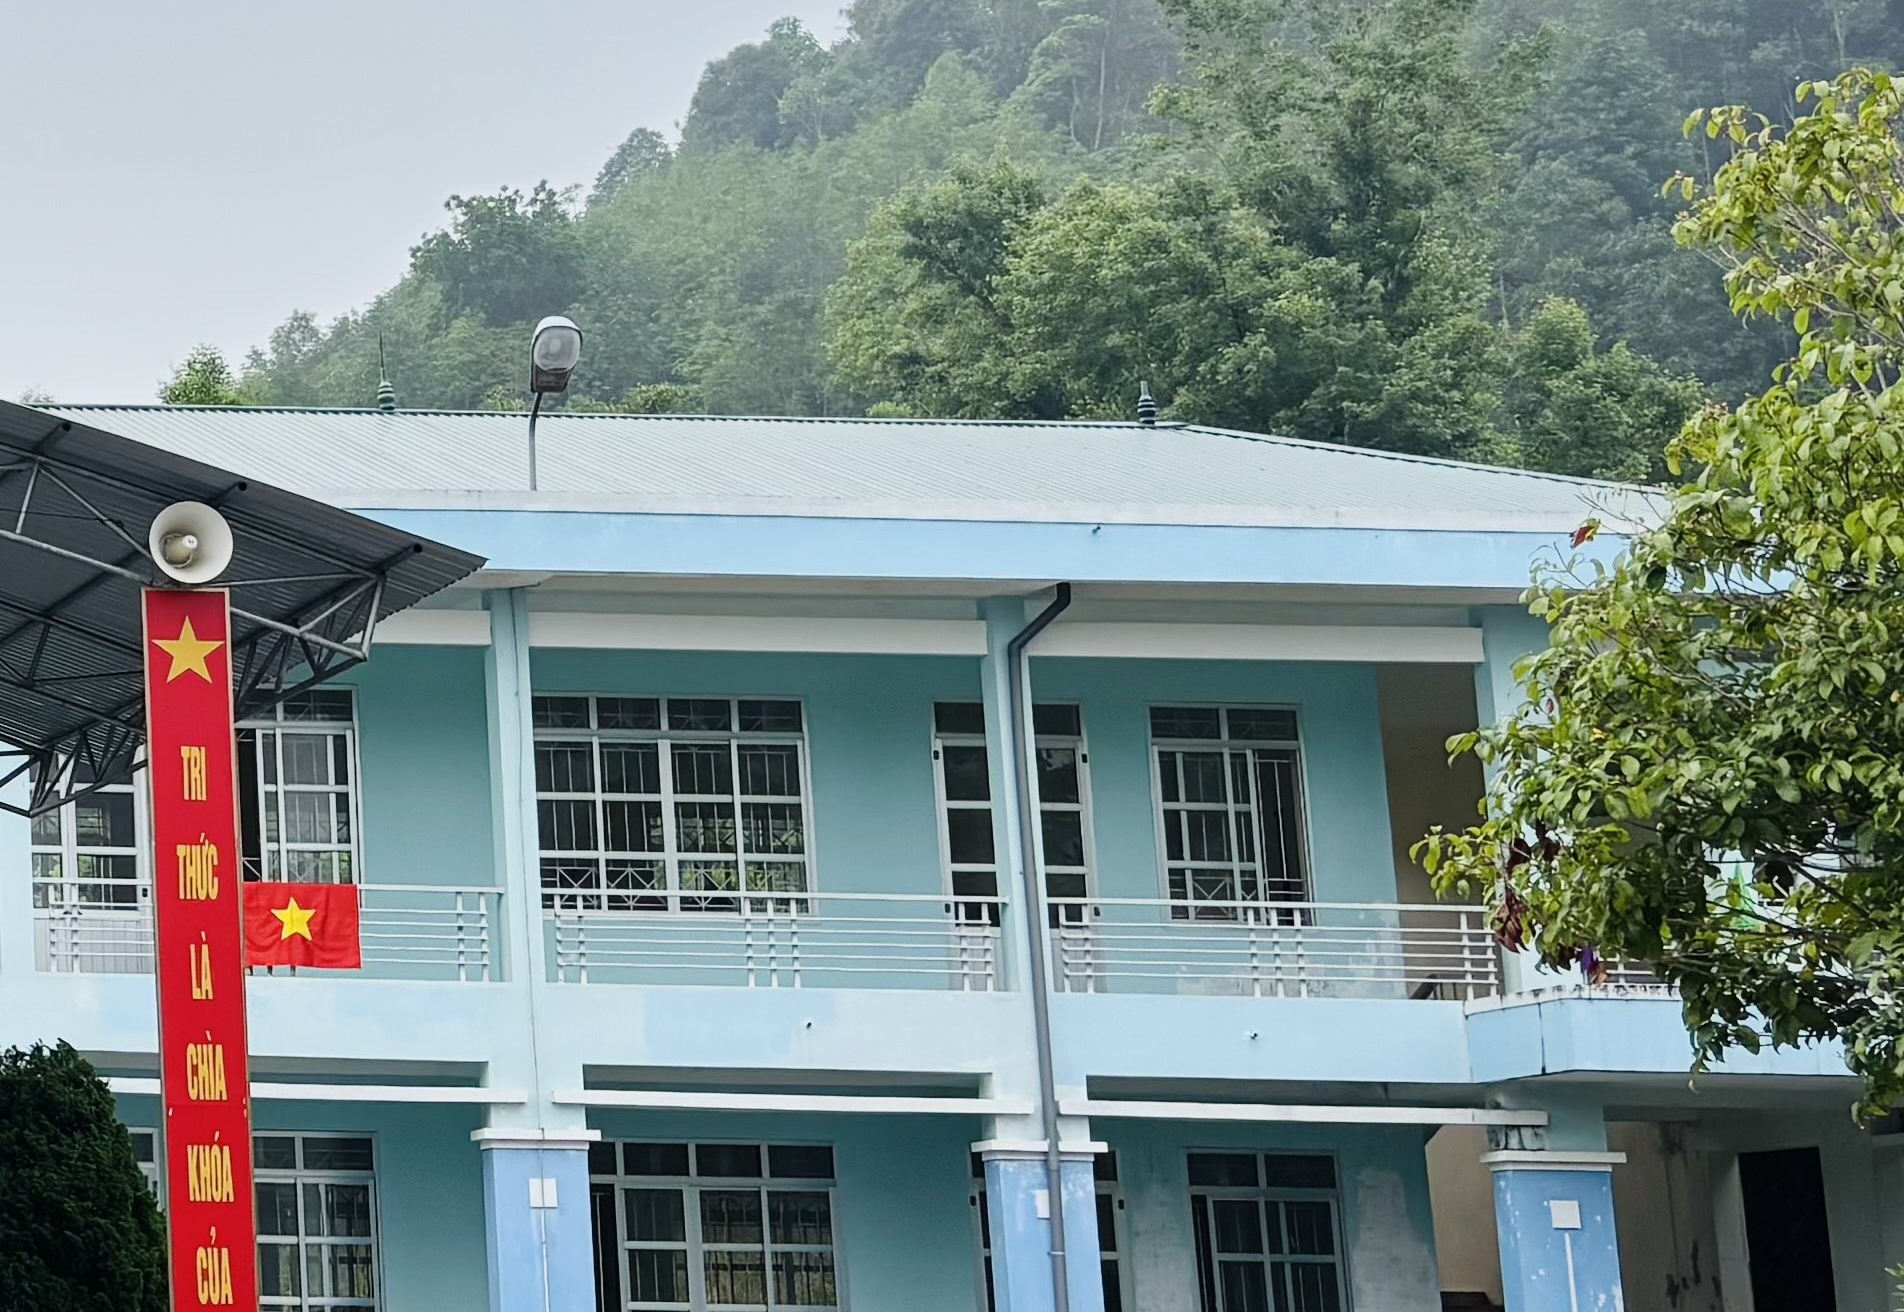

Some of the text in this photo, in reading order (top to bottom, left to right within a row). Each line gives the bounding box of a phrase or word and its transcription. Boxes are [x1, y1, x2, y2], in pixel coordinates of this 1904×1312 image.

[180, 745, 208, 802] TRI
[176, 832, 220, 902] THỨC
[188, 931, 214, 1000] LÀ
[186, 1030, 228, 1101] CHÌA
[186, 1130, 235, 1203] KHÓA
[195, 1226, 234, 1306] CỦA
